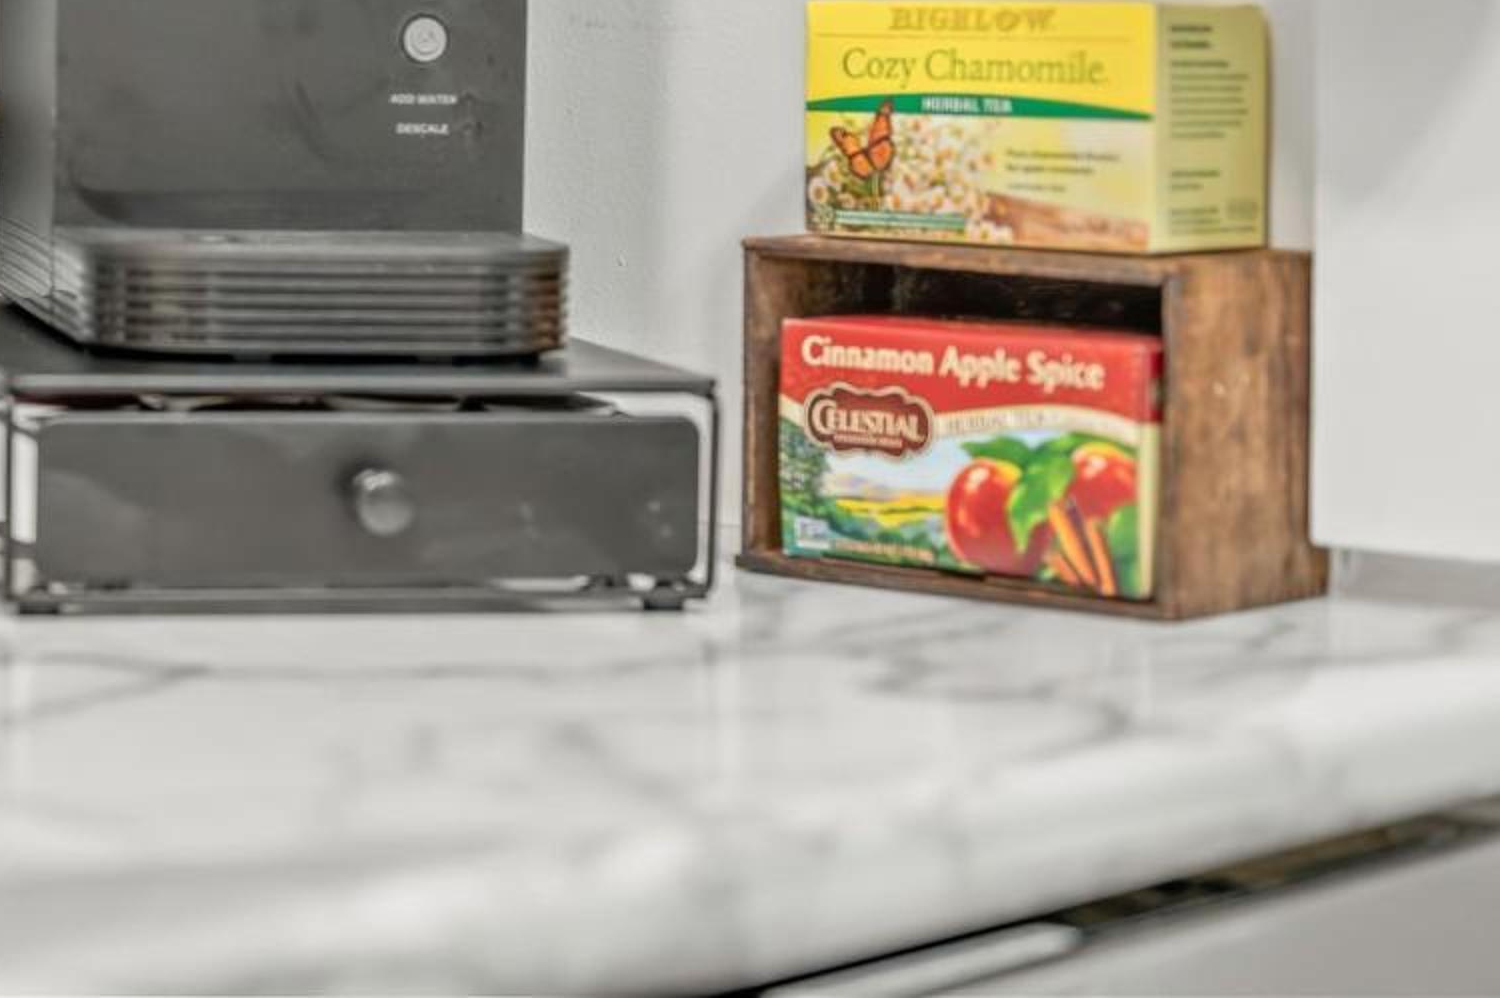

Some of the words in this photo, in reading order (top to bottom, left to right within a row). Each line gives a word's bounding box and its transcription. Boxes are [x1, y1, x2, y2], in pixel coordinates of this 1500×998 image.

[841, 46, 918, 90] Cozy
[801, 335, 934, 376] Cinnamon
[938, 345, 1022, 389] Apple
[1026, 350, 1105, 394] Spice
[811, 398, 926, 443] CELESTIAL
